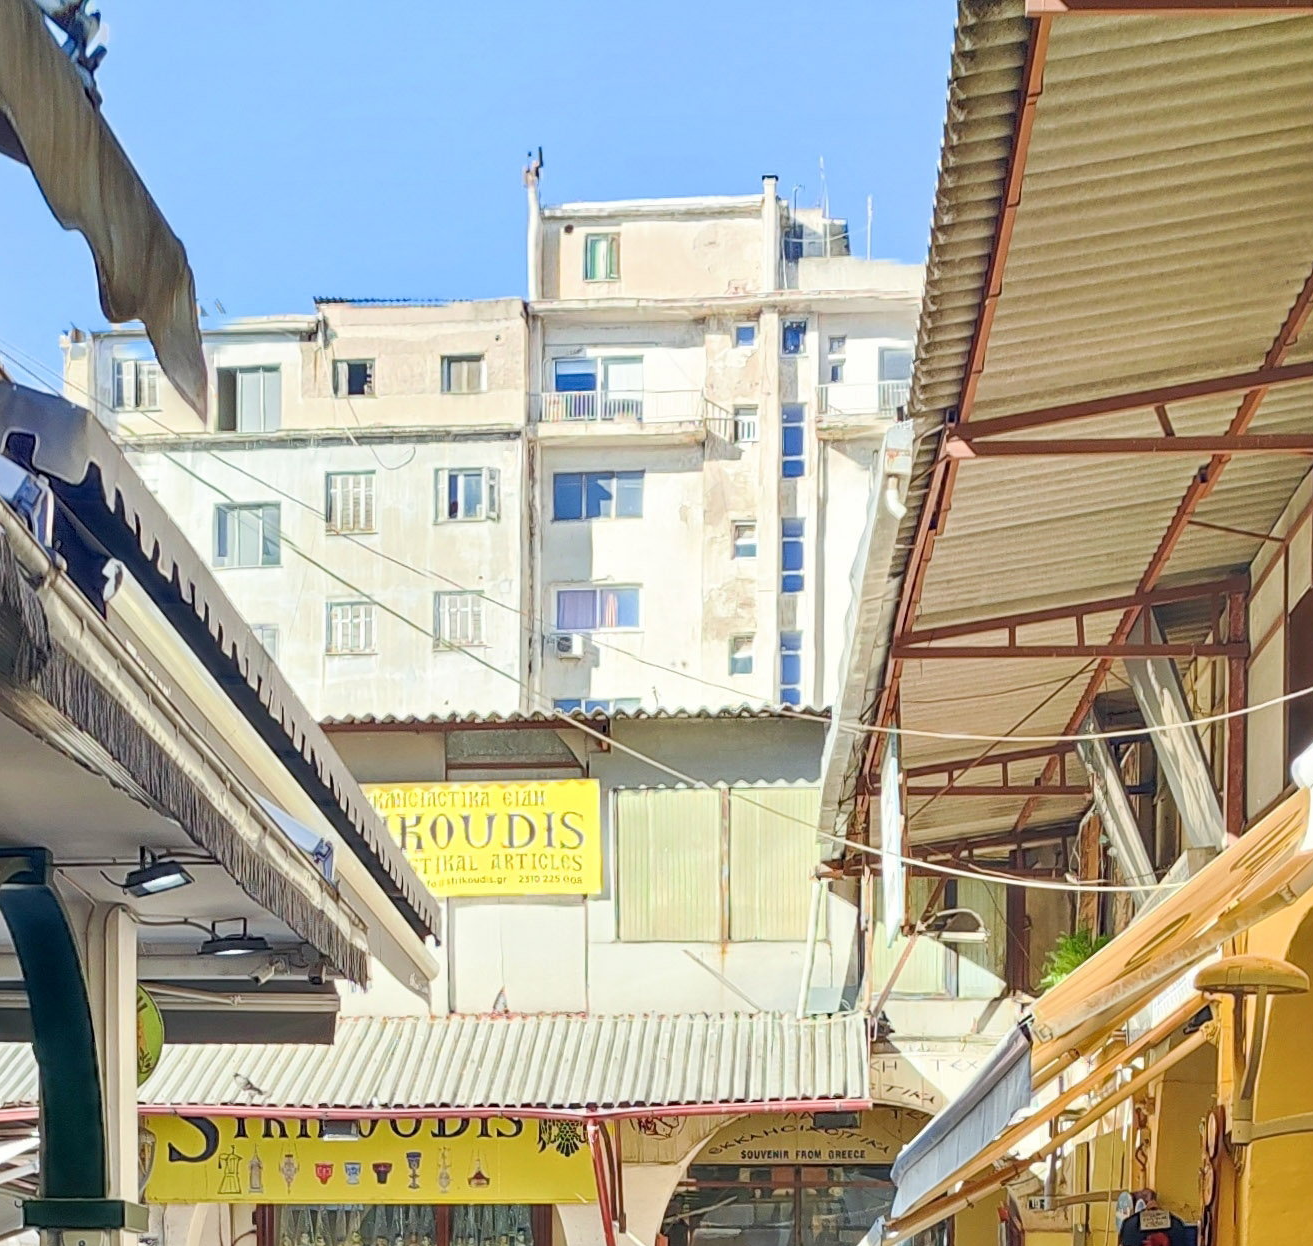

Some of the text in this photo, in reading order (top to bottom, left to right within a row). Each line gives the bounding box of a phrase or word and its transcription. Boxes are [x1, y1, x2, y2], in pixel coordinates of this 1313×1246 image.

[397, 811, 584, 851] KOUDIS
[740, 1149, 866, 1160] SOUVENIR FROM GREECE
